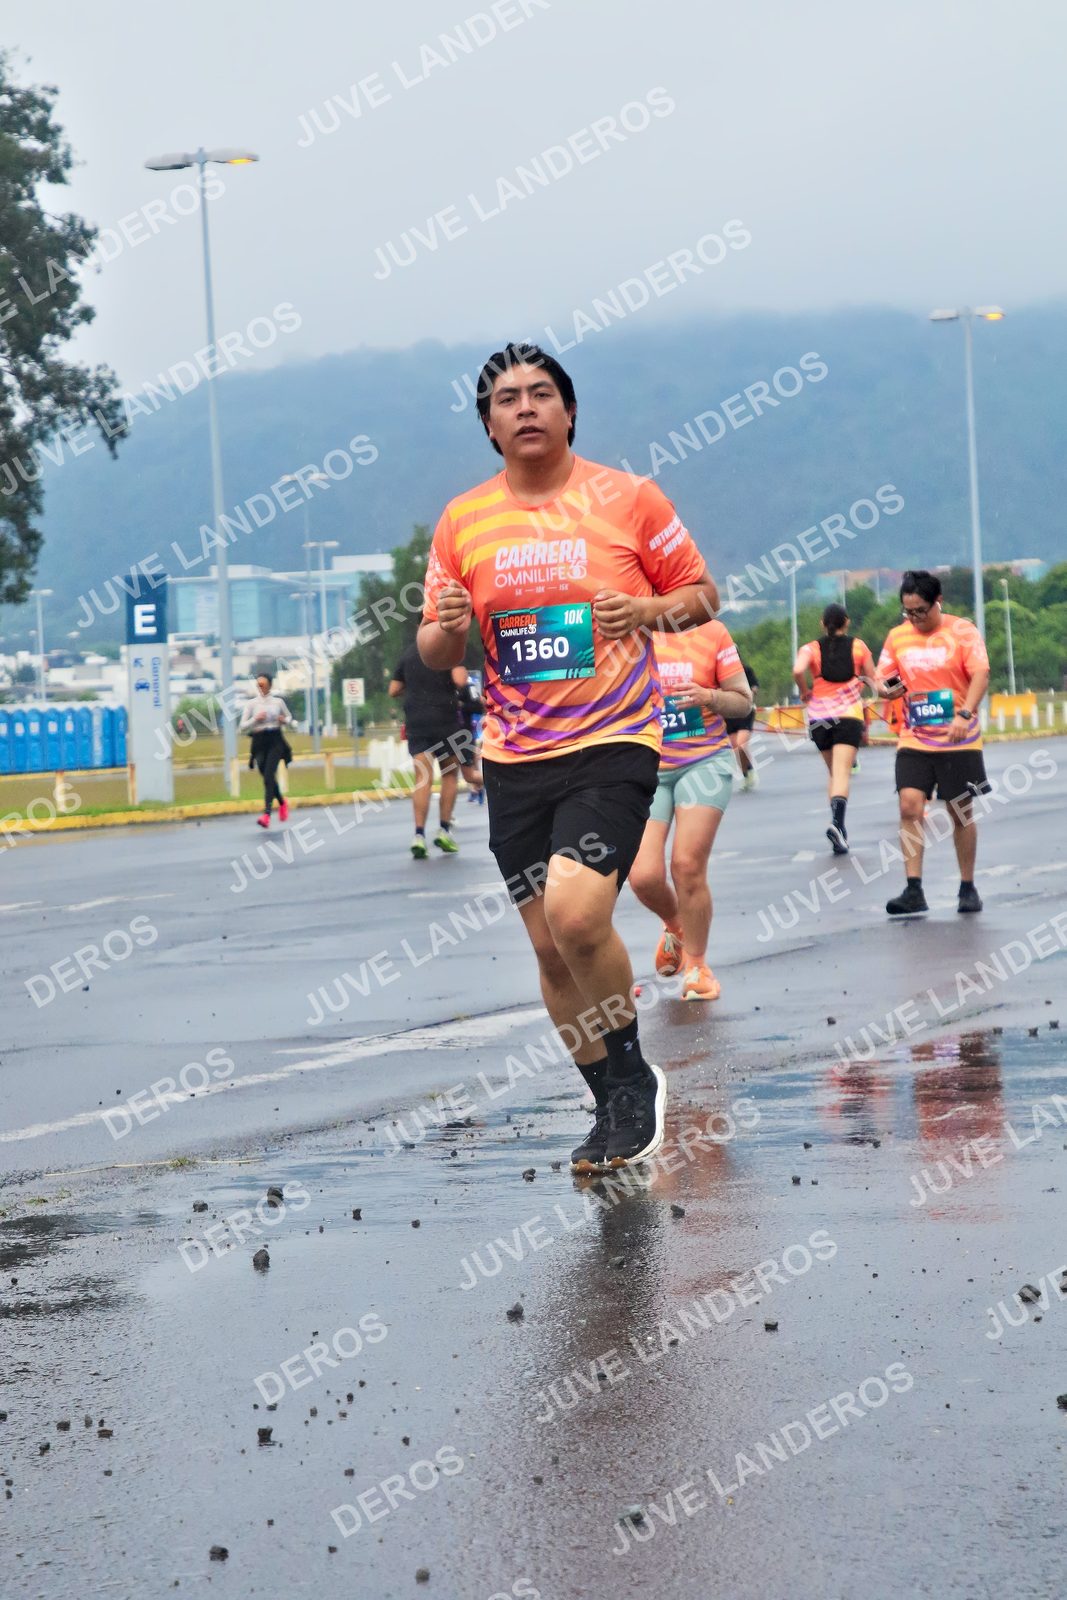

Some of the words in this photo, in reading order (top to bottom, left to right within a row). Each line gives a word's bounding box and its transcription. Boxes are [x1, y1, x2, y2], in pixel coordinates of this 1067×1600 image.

[495, 538, 587, 571] CARRERA
[495, 566, 566, 588] OMNILIFE
[134, 604, 157, 635] E
[499, 614, 537, 629] CARRERA
[564, 609, 584, 625] 10K
[500, 628, 528, 637] OMNILIFE
[512, 636, 569, 662] 1360
[916, 704, 944, 716] 1604
[661, 712, 686, 728] 521
